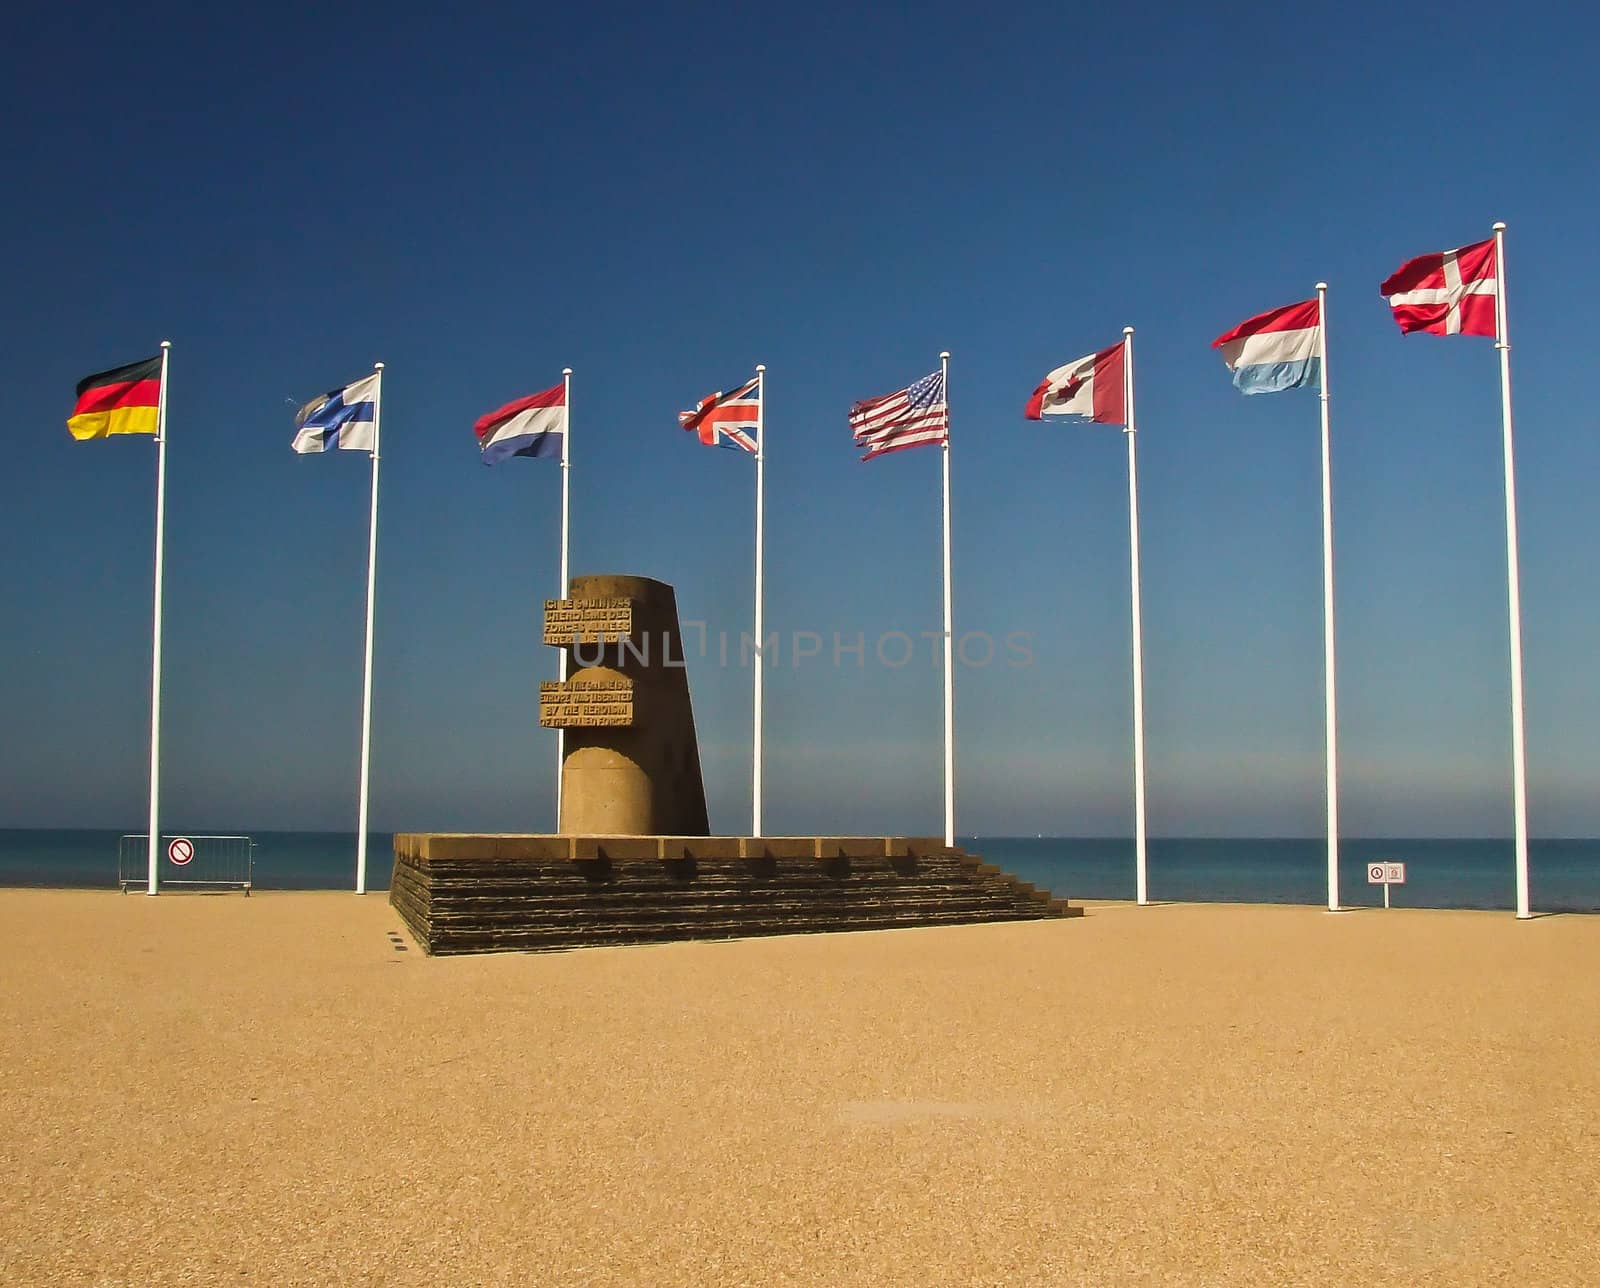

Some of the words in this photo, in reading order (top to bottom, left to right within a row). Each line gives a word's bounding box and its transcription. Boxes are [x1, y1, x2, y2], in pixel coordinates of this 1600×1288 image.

[562, 600, 573, 610] LE
[545, 622, 585, 633] FORCES
[546, 706, 559, 716] BY
[564, 705, 579, 716] THE
[583, 704, 627, 716] HEROISM
